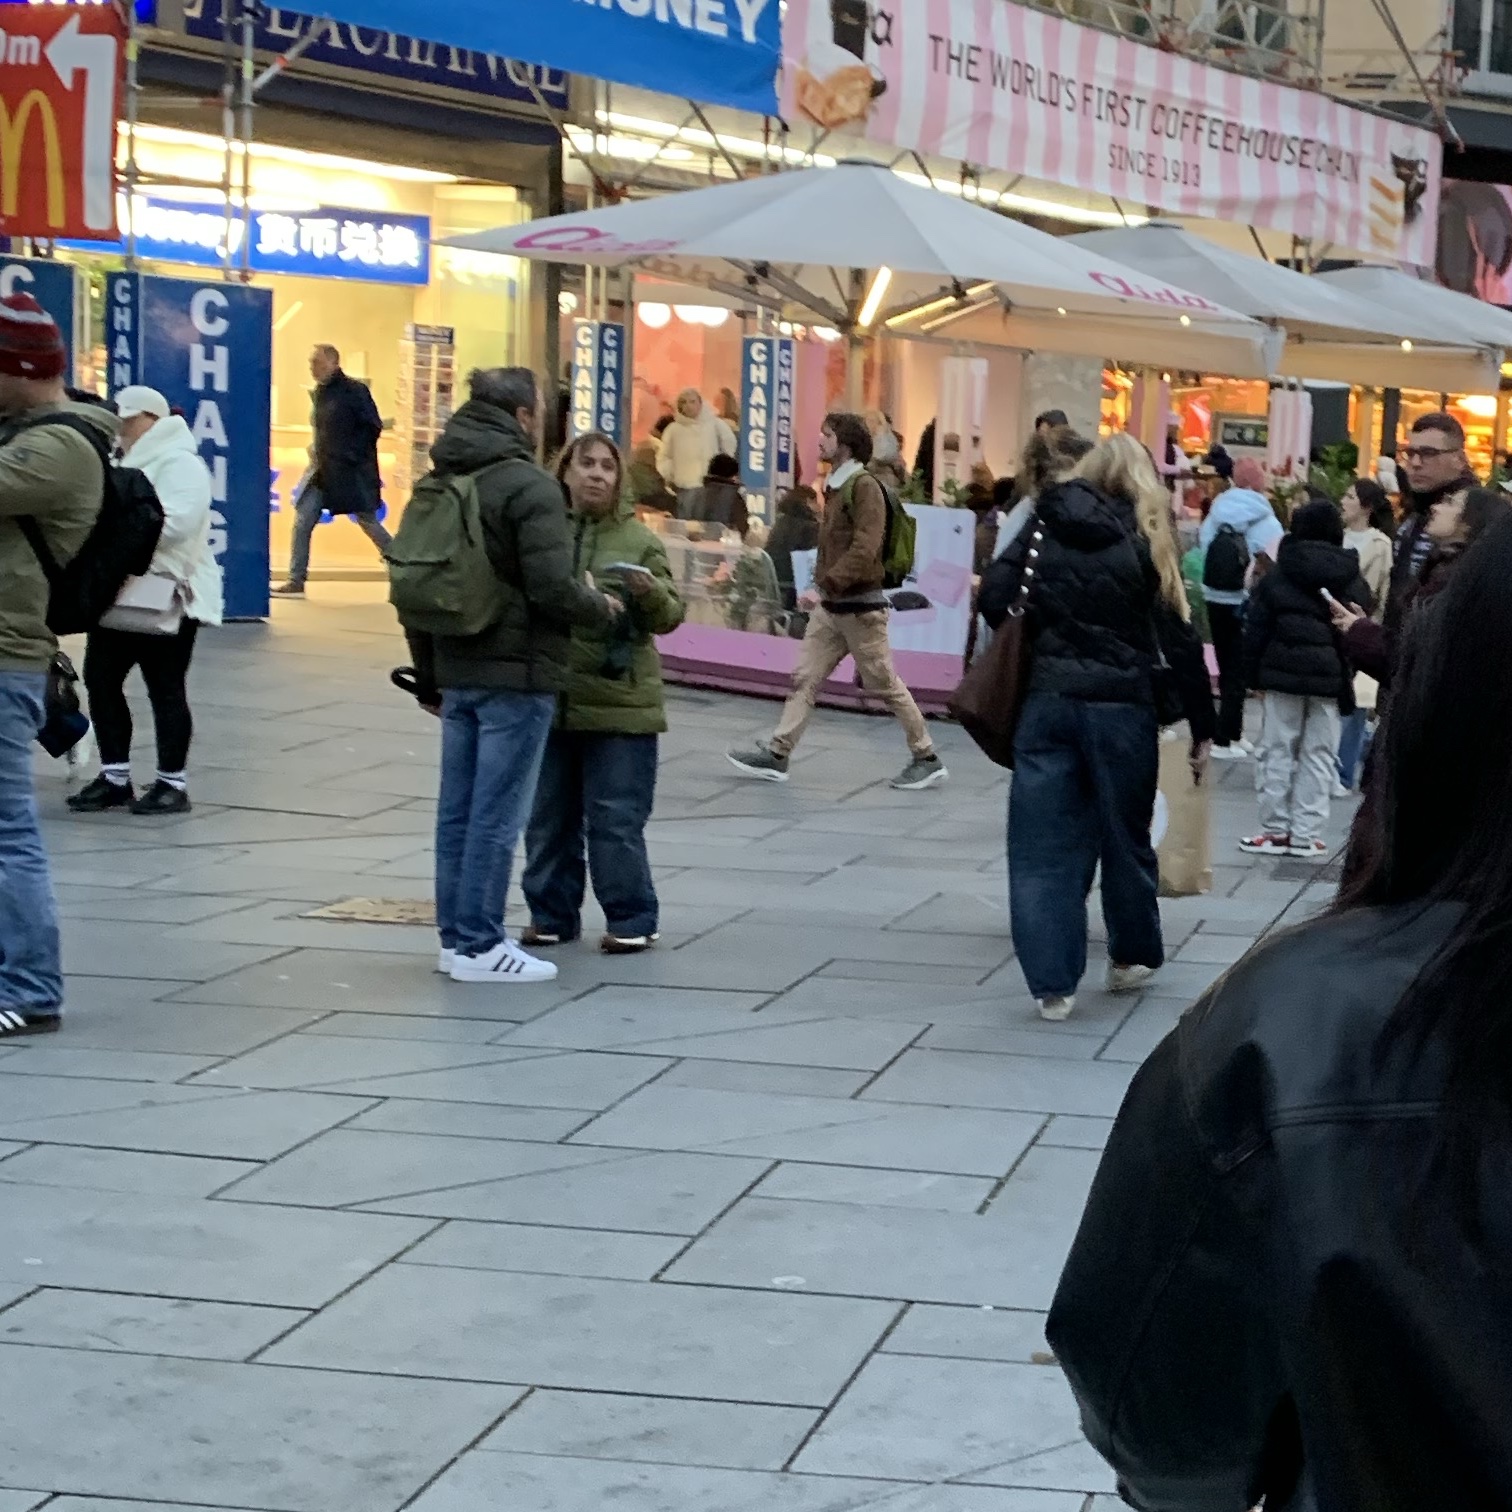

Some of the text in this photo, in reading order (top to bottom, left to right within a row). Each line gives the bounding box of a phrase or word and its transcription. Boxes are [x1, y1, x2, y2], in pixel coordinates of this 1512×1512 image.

[928, 34, 982, 82] THE
[989, 50, 1077, 112] WORLD'S
[1081, 83, 1147, 131] FIRST
[1108, 142, 1156, 179] SINCE
[573, 326, 593, 441] CHANG
[600, 327, 618, 441] CHANG
[748, 341, 767, 472] CHANGE
